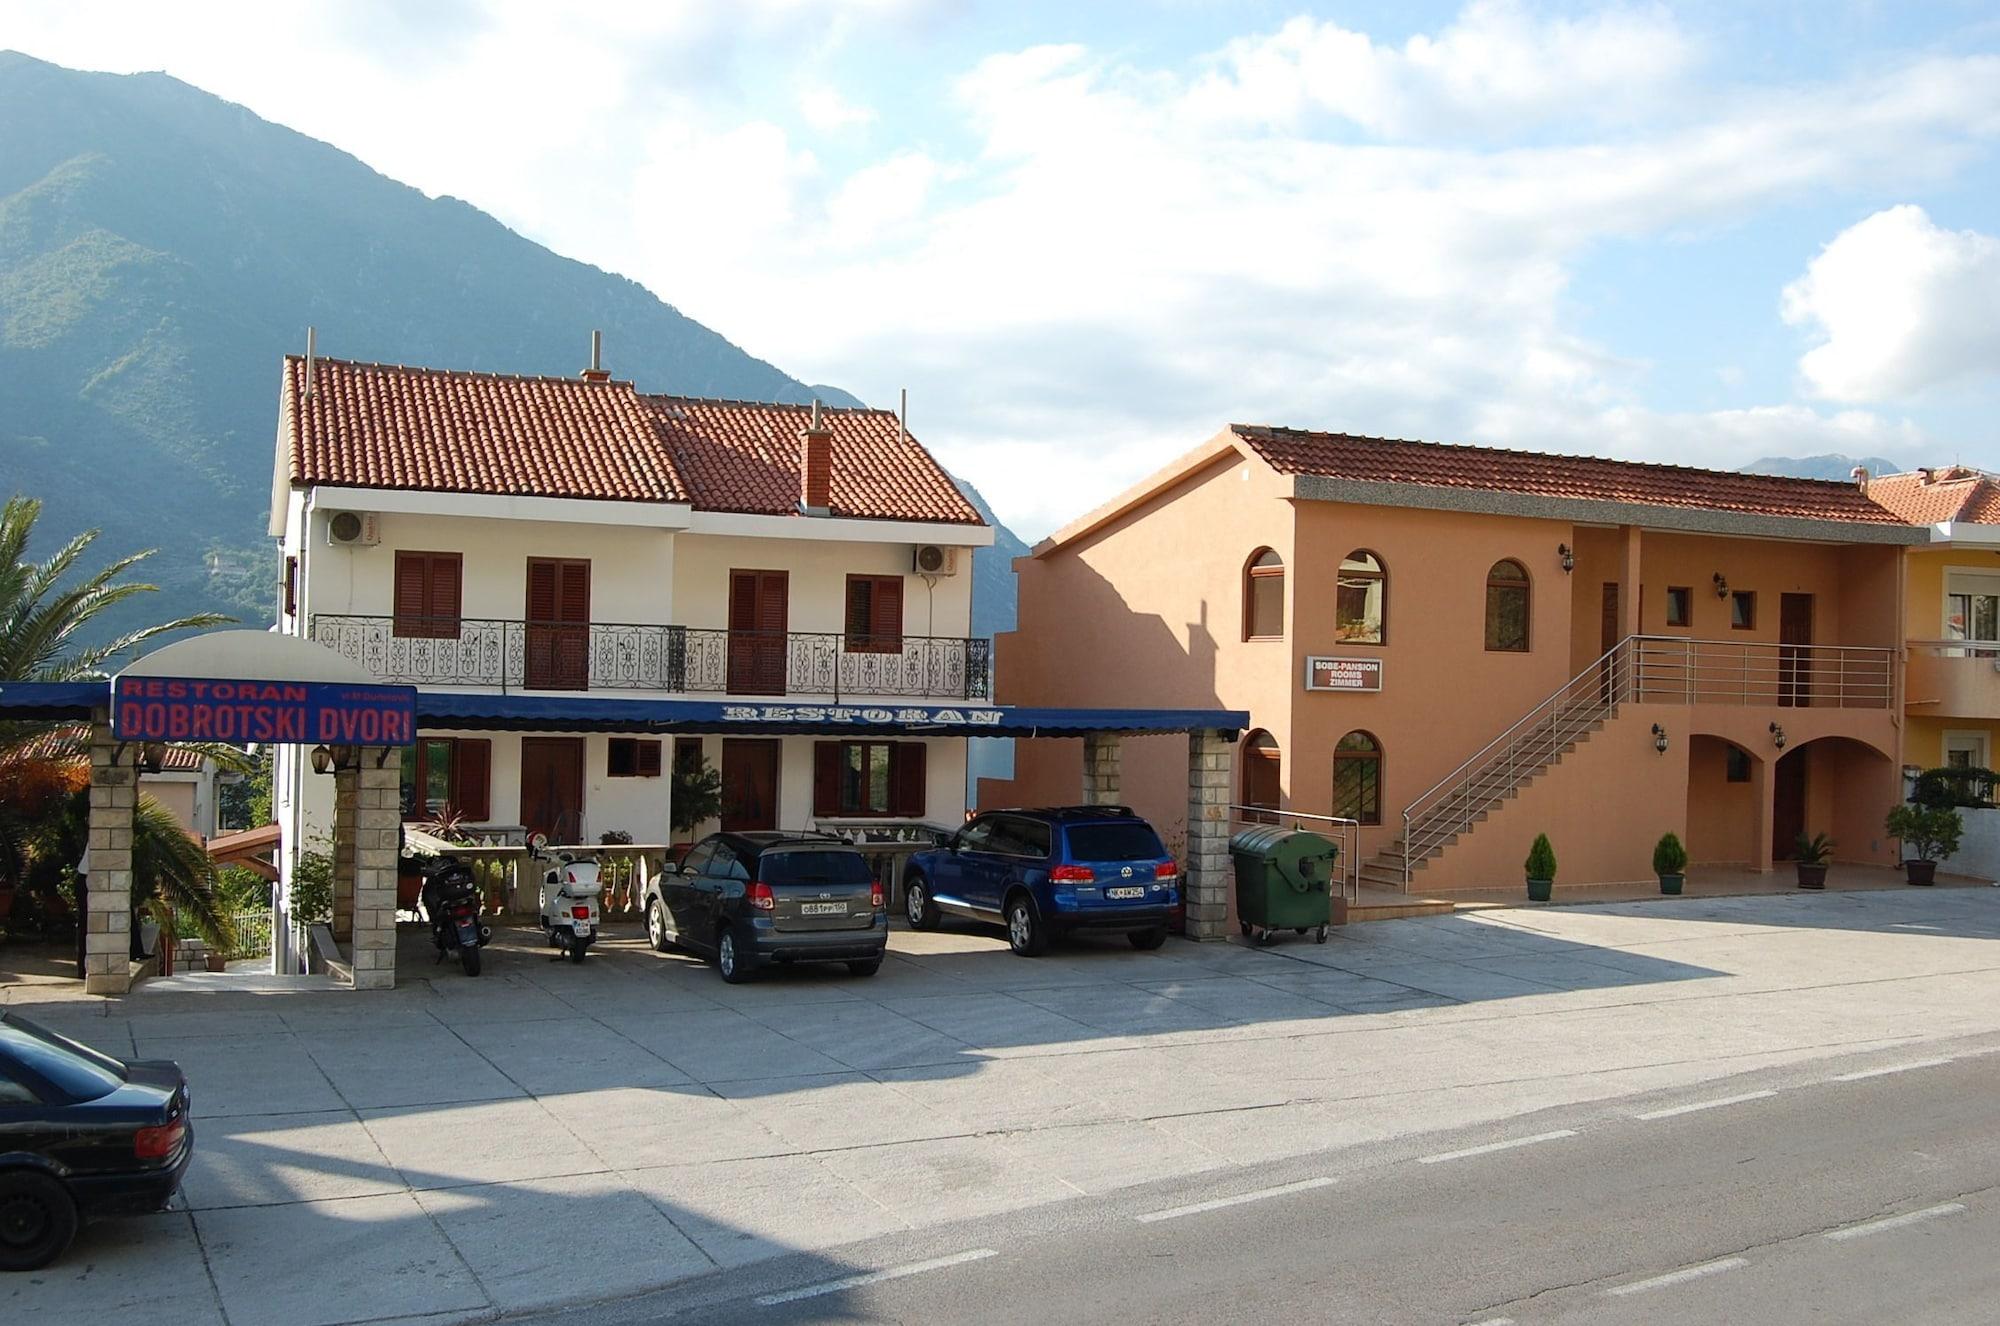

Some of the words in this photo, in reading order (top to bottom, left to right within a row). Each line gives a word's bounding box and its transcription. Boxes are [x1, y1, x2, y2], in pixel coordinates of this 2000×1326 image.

[1315, 661, 1378, 672] SOBE-PANSION
[1331, 670, 1362, 679] ROOMS
[122, 680, 306, 700] RESTORAN
[1329, 679, 1363, 687] ZIMMER
[121, 702, 305, 740] DOBROTSKI
[319, 708, 410, 742] DVORI
[722, 706, 1004, 725] RESTORAN
